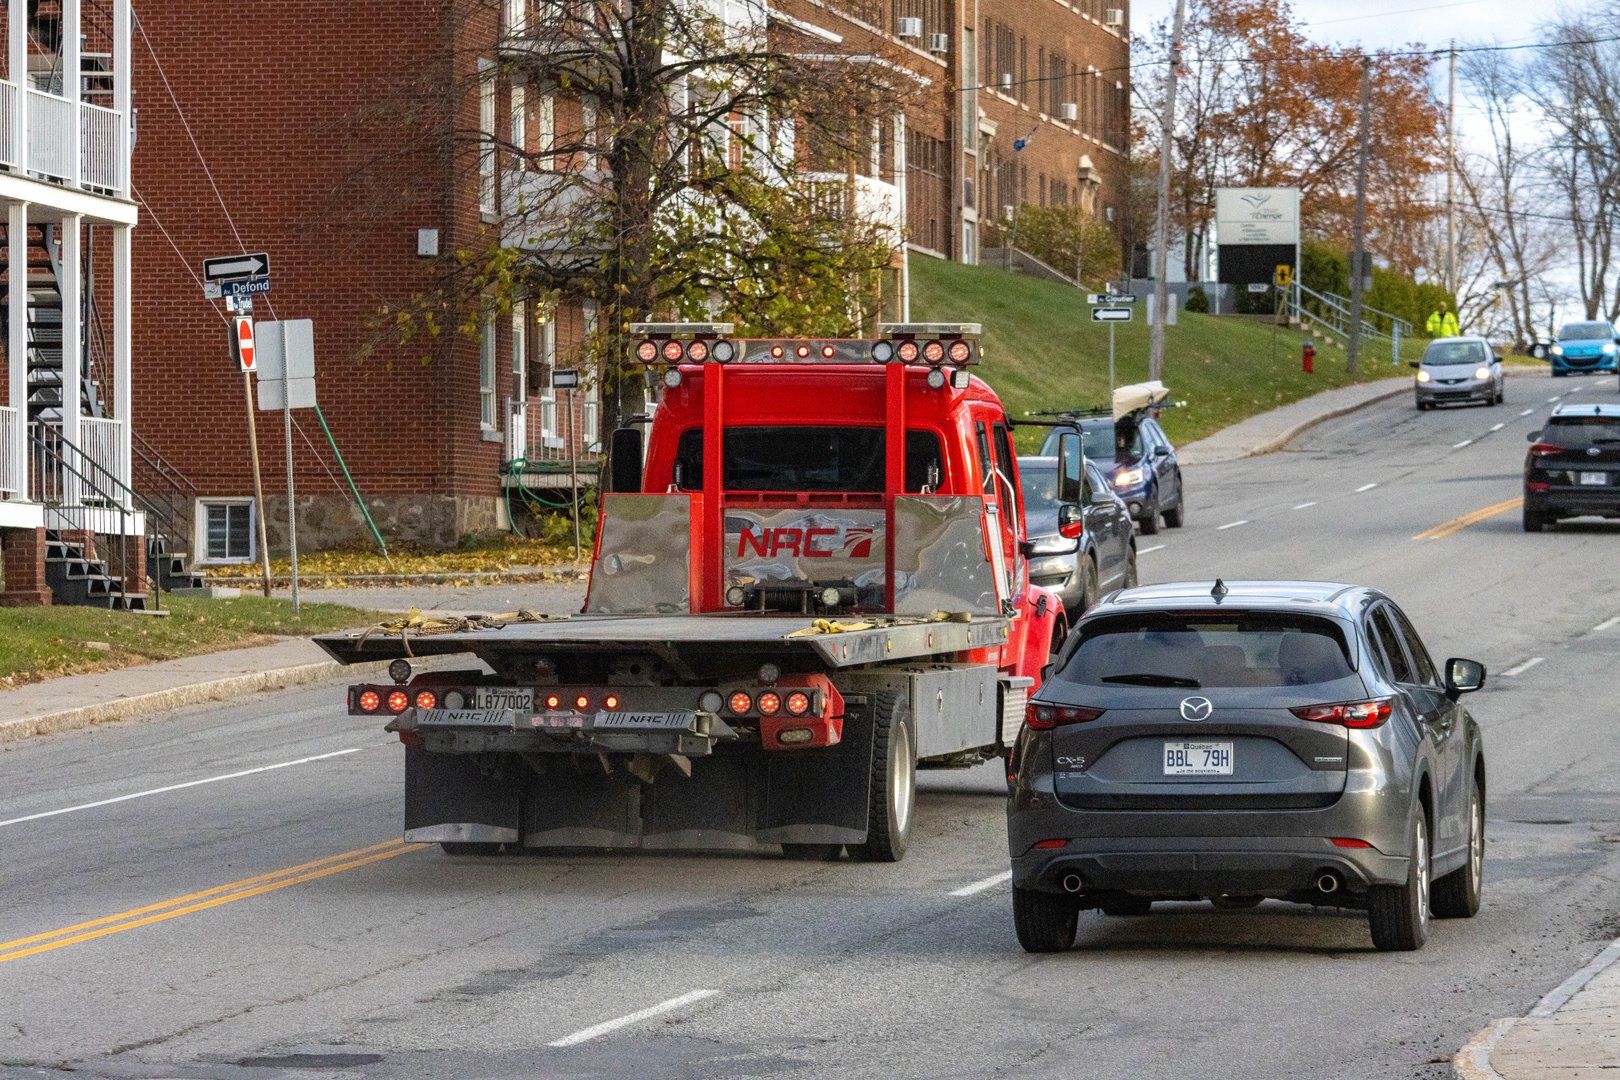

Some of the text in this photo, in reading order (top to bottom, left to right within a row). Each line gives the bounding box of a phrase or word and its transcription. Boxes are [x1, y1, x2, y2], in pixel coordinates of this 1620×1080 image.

[232, 280, 269, 293] Defond
[737, 527, 836, 558] NRC
[477, 694, 531, 710] L877002
[448, 712, 482, 720] NRC
[629, 715, 663, 723] NRC
[1057, 756, 1085, 764] CX-5
[1167, 750, 1229, 767] BBL 79H
